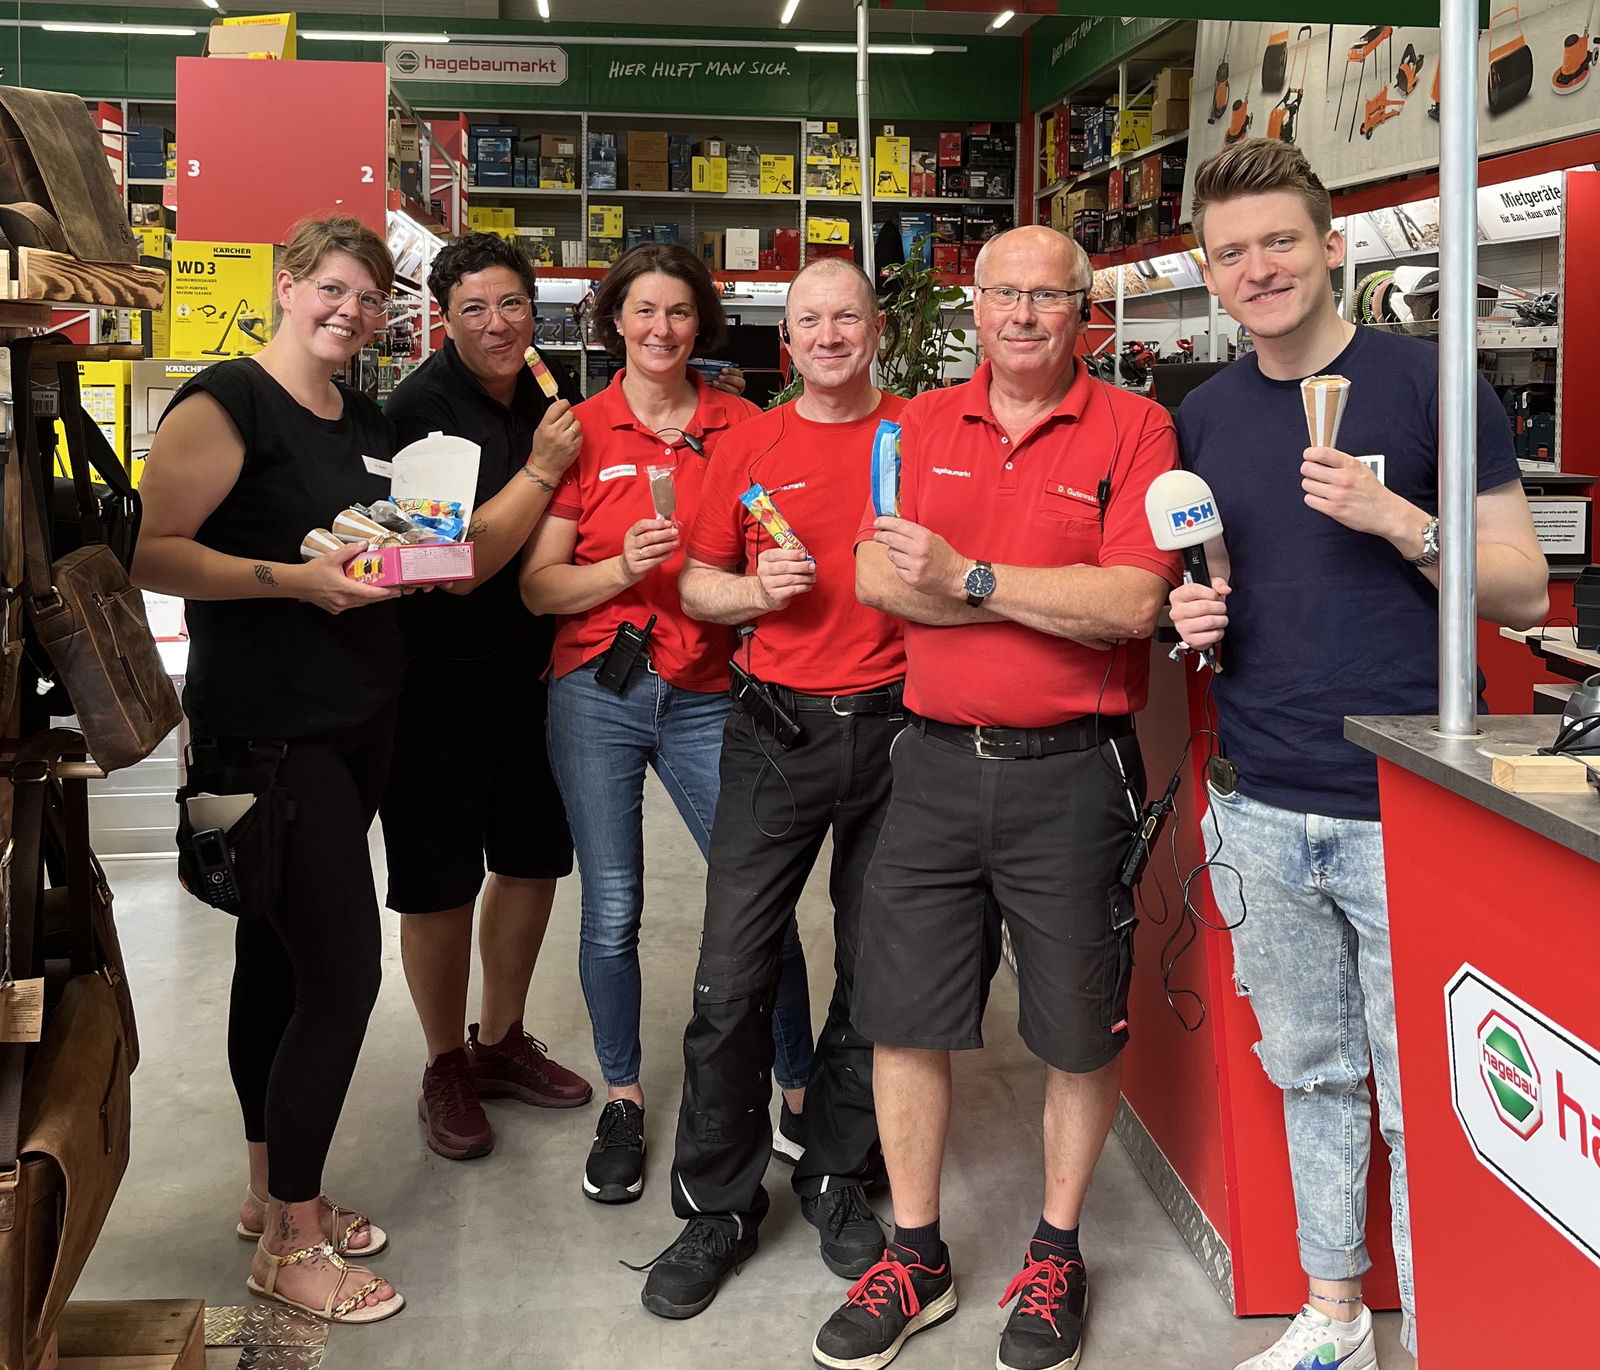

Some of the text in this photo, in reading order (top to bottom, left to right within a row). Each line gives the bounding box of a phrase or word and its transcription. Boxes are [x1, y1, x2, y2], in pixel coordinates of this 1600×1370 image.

[425, 55, 556, 73] hagebaumarkt
[609, 61, 791, 78] HIER HILFT MAN SICH.
[187, 159, 200, 177] 3
[361, 166, 374, 183] 2
[1500, 185, 1561, 208] Mietgeräte
[1525, 211, 1544, 220] Haus
[1543, 206, 1558, 217] und
[177, 260, 216, 275] WD 3
[166, 364, 208, 373] KÄRCHE
[1483, 1043, 1538, 1102] hagebau
